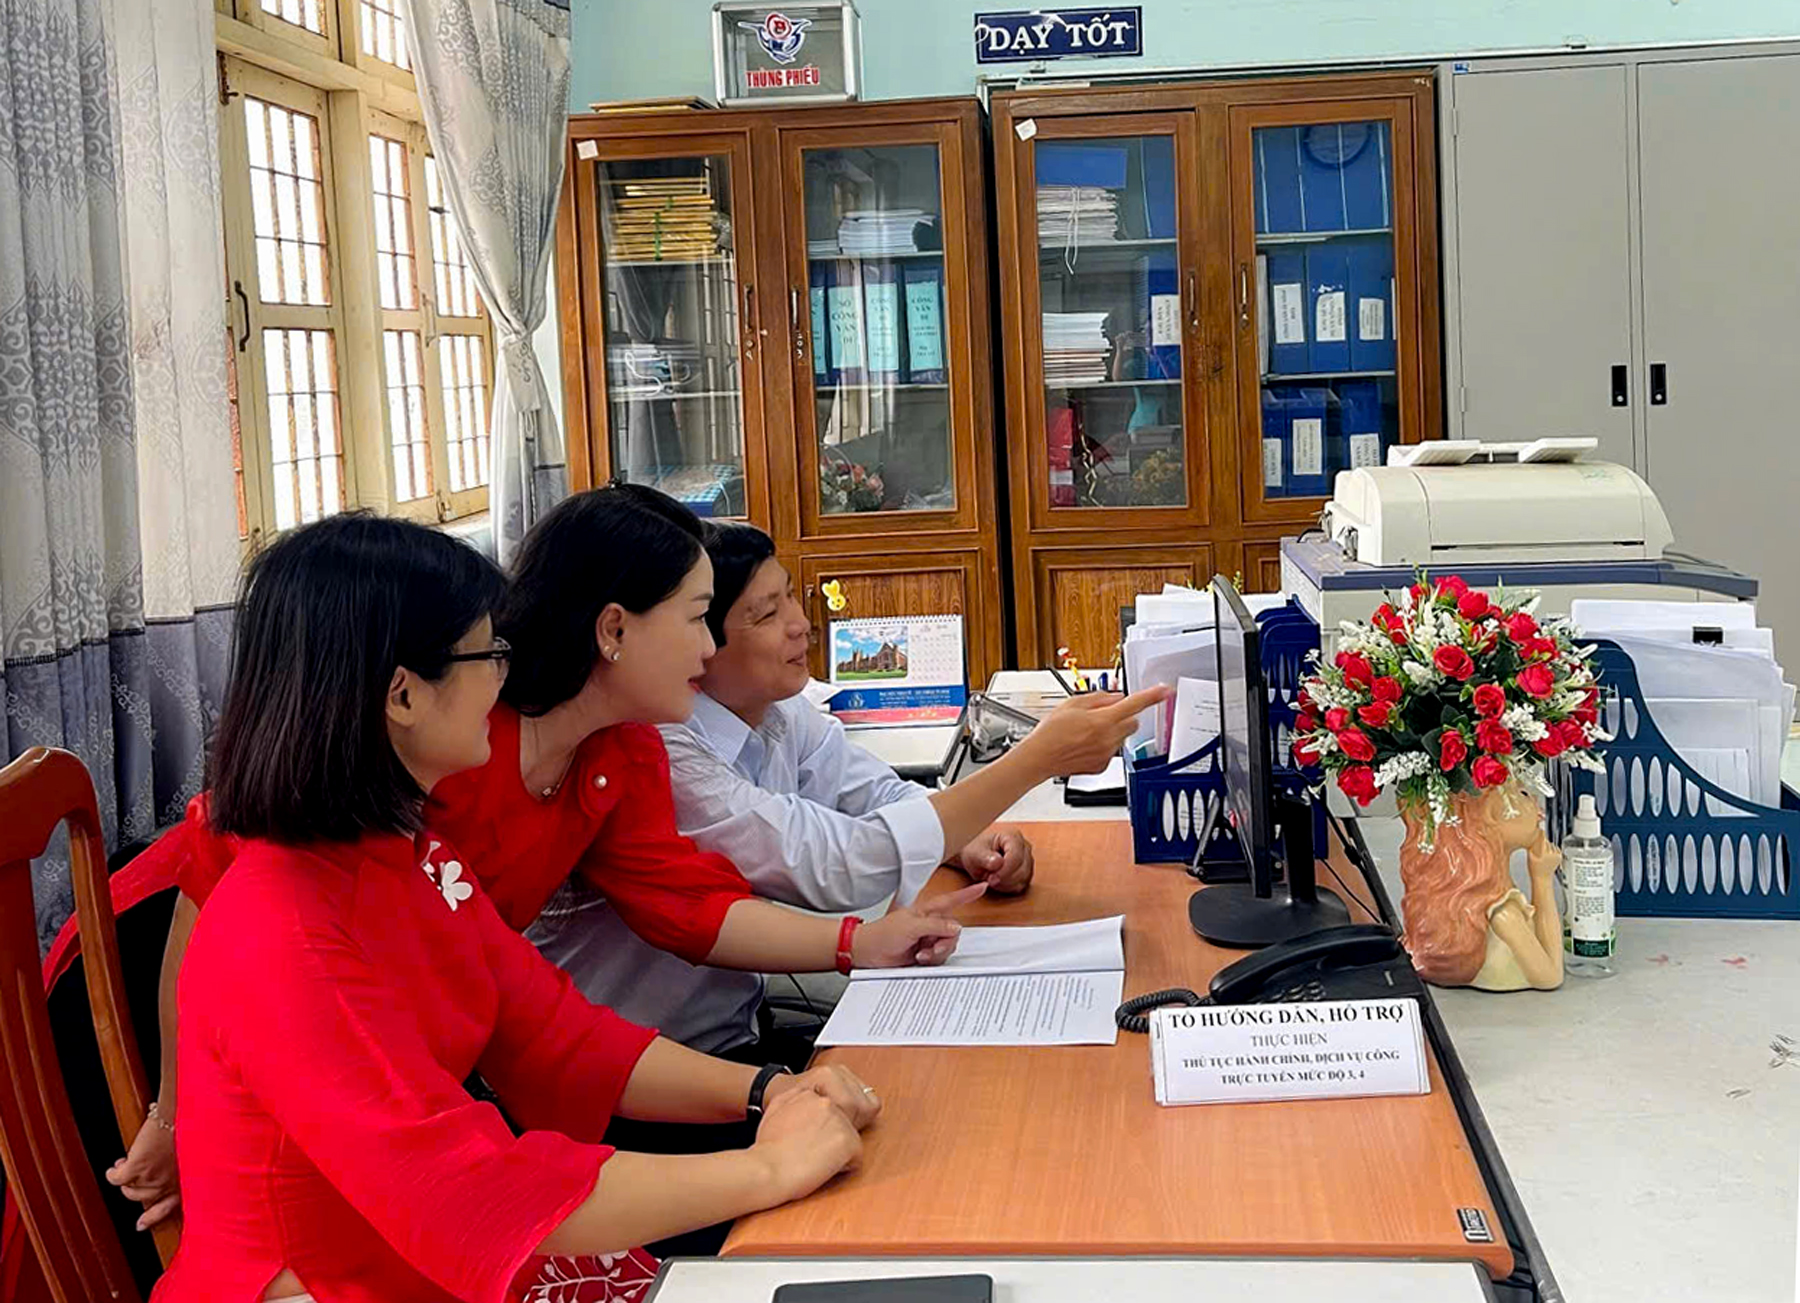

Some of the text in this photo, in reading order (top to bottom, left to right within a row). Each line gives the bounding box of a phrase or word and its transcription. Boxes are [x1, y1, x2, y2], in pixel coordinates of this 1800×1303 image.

[988, 13, 1132, 55] DẠY TỐT
[746, 67, 783, 88] THÙNG
[1201, 1008, 1273, 1027] HƯỚNG
[1361, 1003, 1404, 1023] TRỢ
[1251, 1032, 1328, 1048] THỰC HIỆN
[1210, 1056, 1234, 1069] TỤC
[1236, 1054, 1269, 1066] HÀNH
[1315, 1052, 1345, 1064] DỊCH
[1347, 1051, 1363, 1063] VỤ
[1365, 1048, 1400, 1061] CÔNG
[1221, 1073, 1254, 1086] TRỰC
[1256, 1070, 1295, 1084] TUYẾN
[1298, 1069, 1325, 1081] MỨC
[1359, 1070, 1365, 1079] 4
